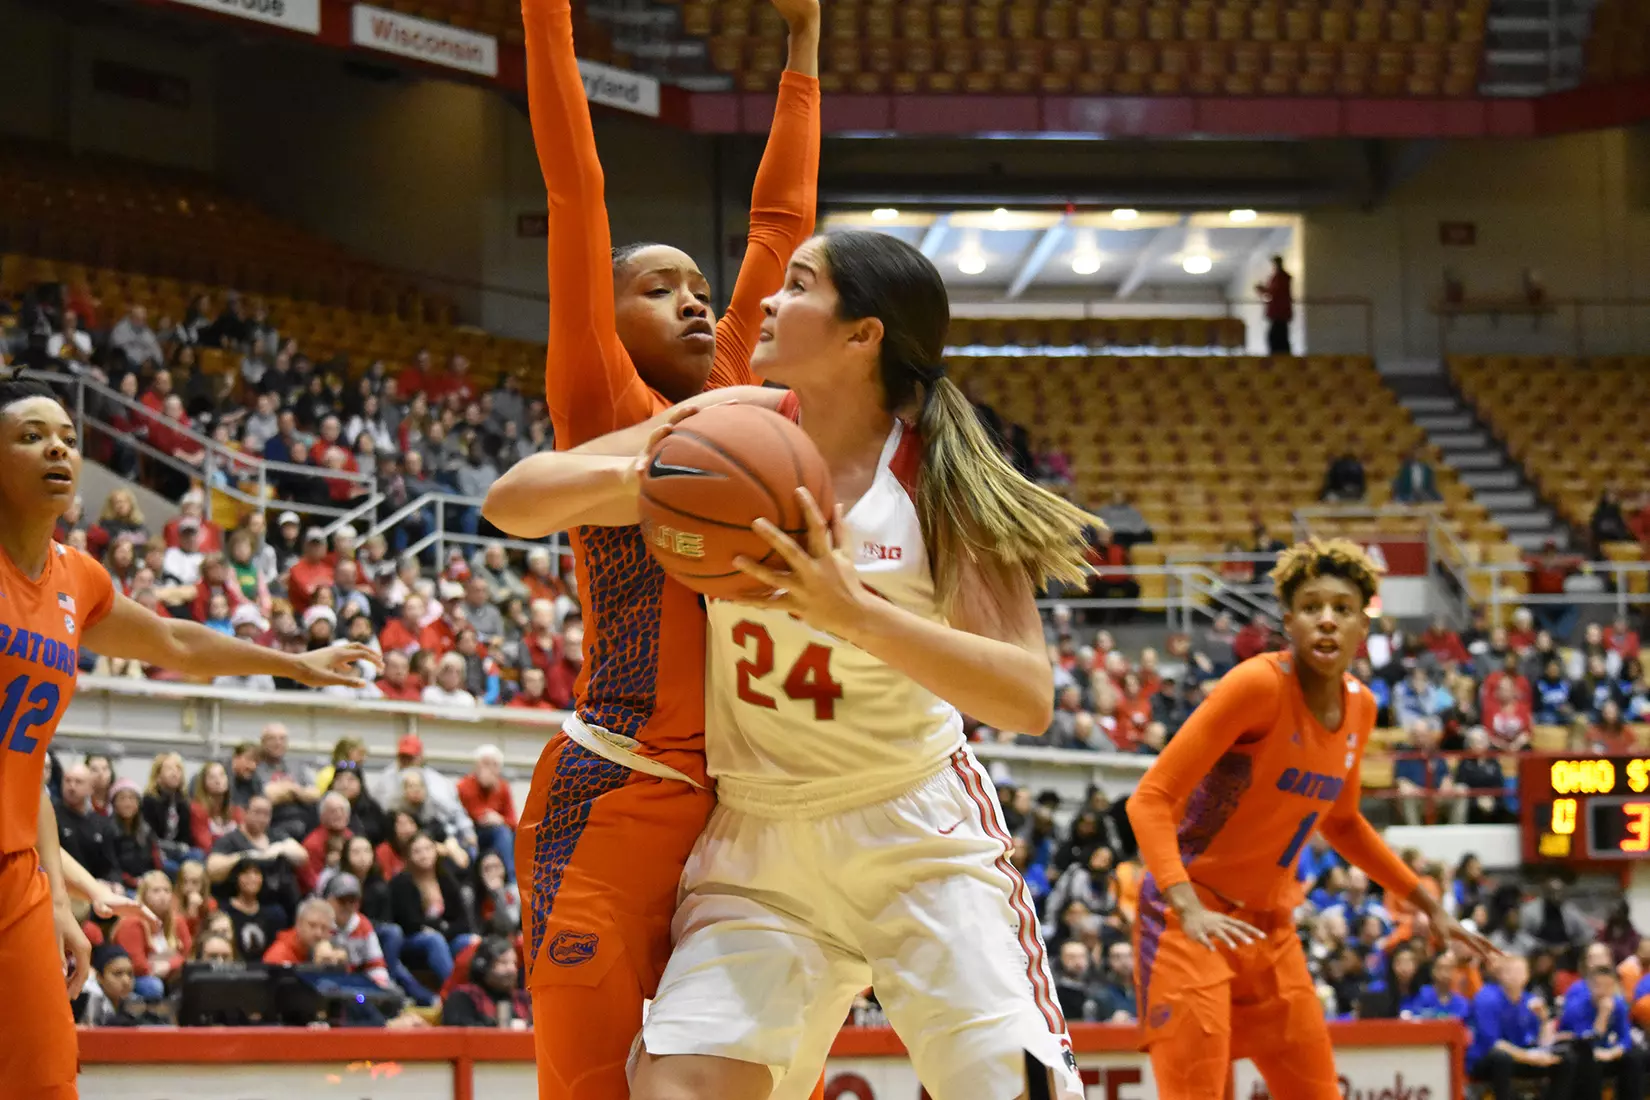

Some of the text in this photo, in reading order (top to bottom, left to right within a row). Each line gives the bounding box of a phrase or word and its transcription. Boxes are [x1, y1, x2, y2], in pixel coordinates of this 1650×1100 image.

[371, 14, 483, 62] Wisconsin
[581, 73, 639, 104] ryland
[731, 619, 843, 720] 24
[0, 673, 60, 754] 12
[1550, 758, 1650, 794] OHIO S
[1277, 811, 1319, 869] 1
[1619, 802, 1650, 852] 3
